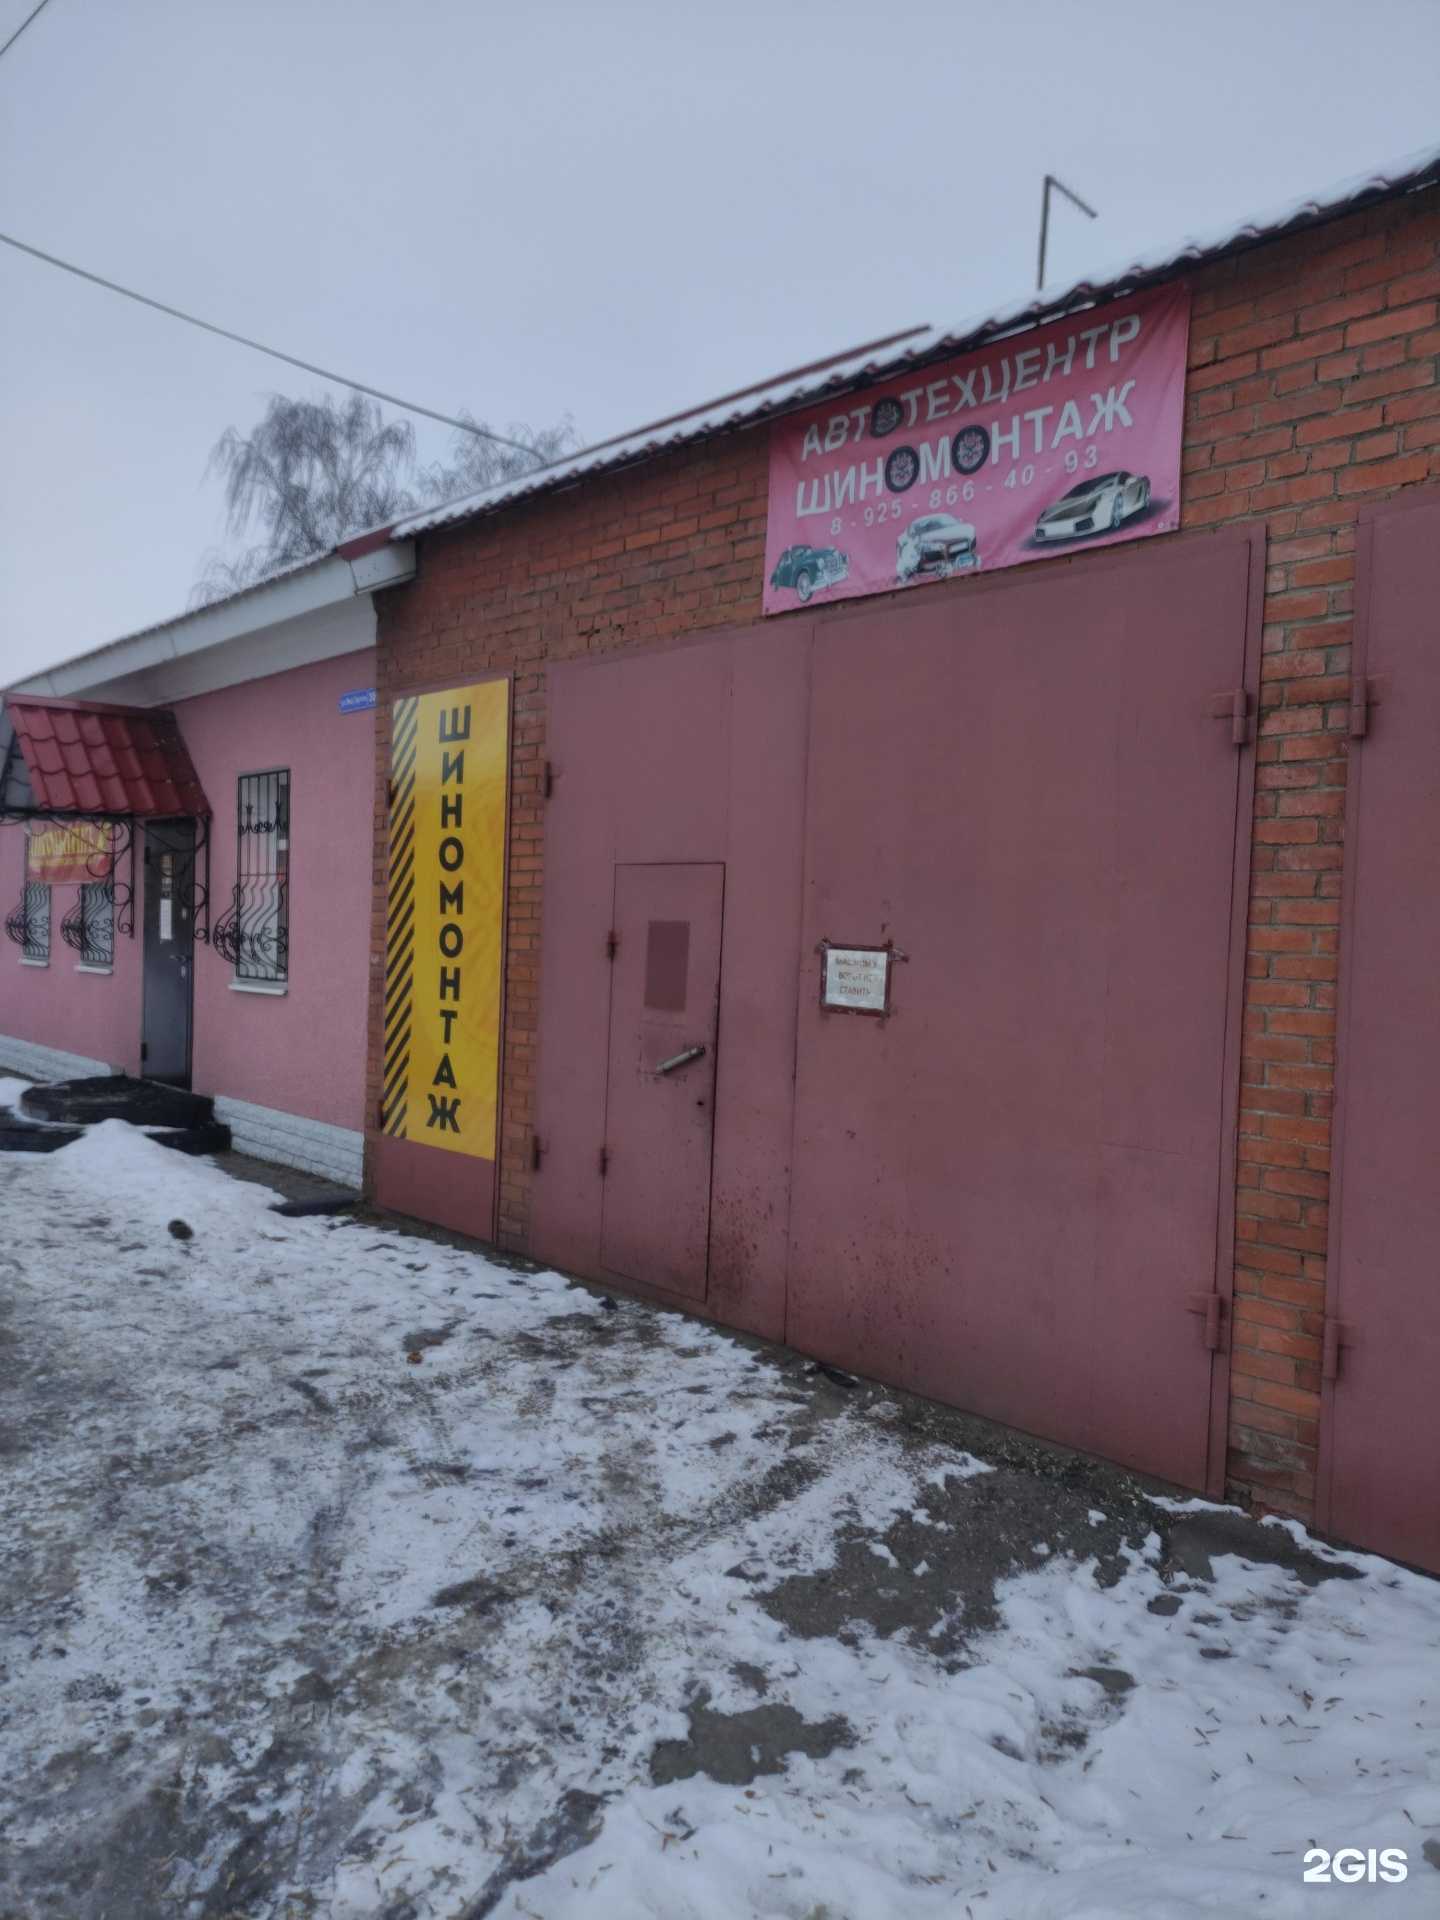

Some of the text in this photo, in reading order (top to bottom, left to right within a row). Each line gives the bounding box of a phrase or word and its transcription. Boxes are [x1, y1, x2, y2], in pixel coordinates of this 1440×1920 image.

[795, 379, 1137, 519] ШИНОМОНТАЖ
[801, 314, 1142, 462] АВТОТЕХЦЕНТР
[425, 705, 472, 1134] ШИНОМОНТАЖ
